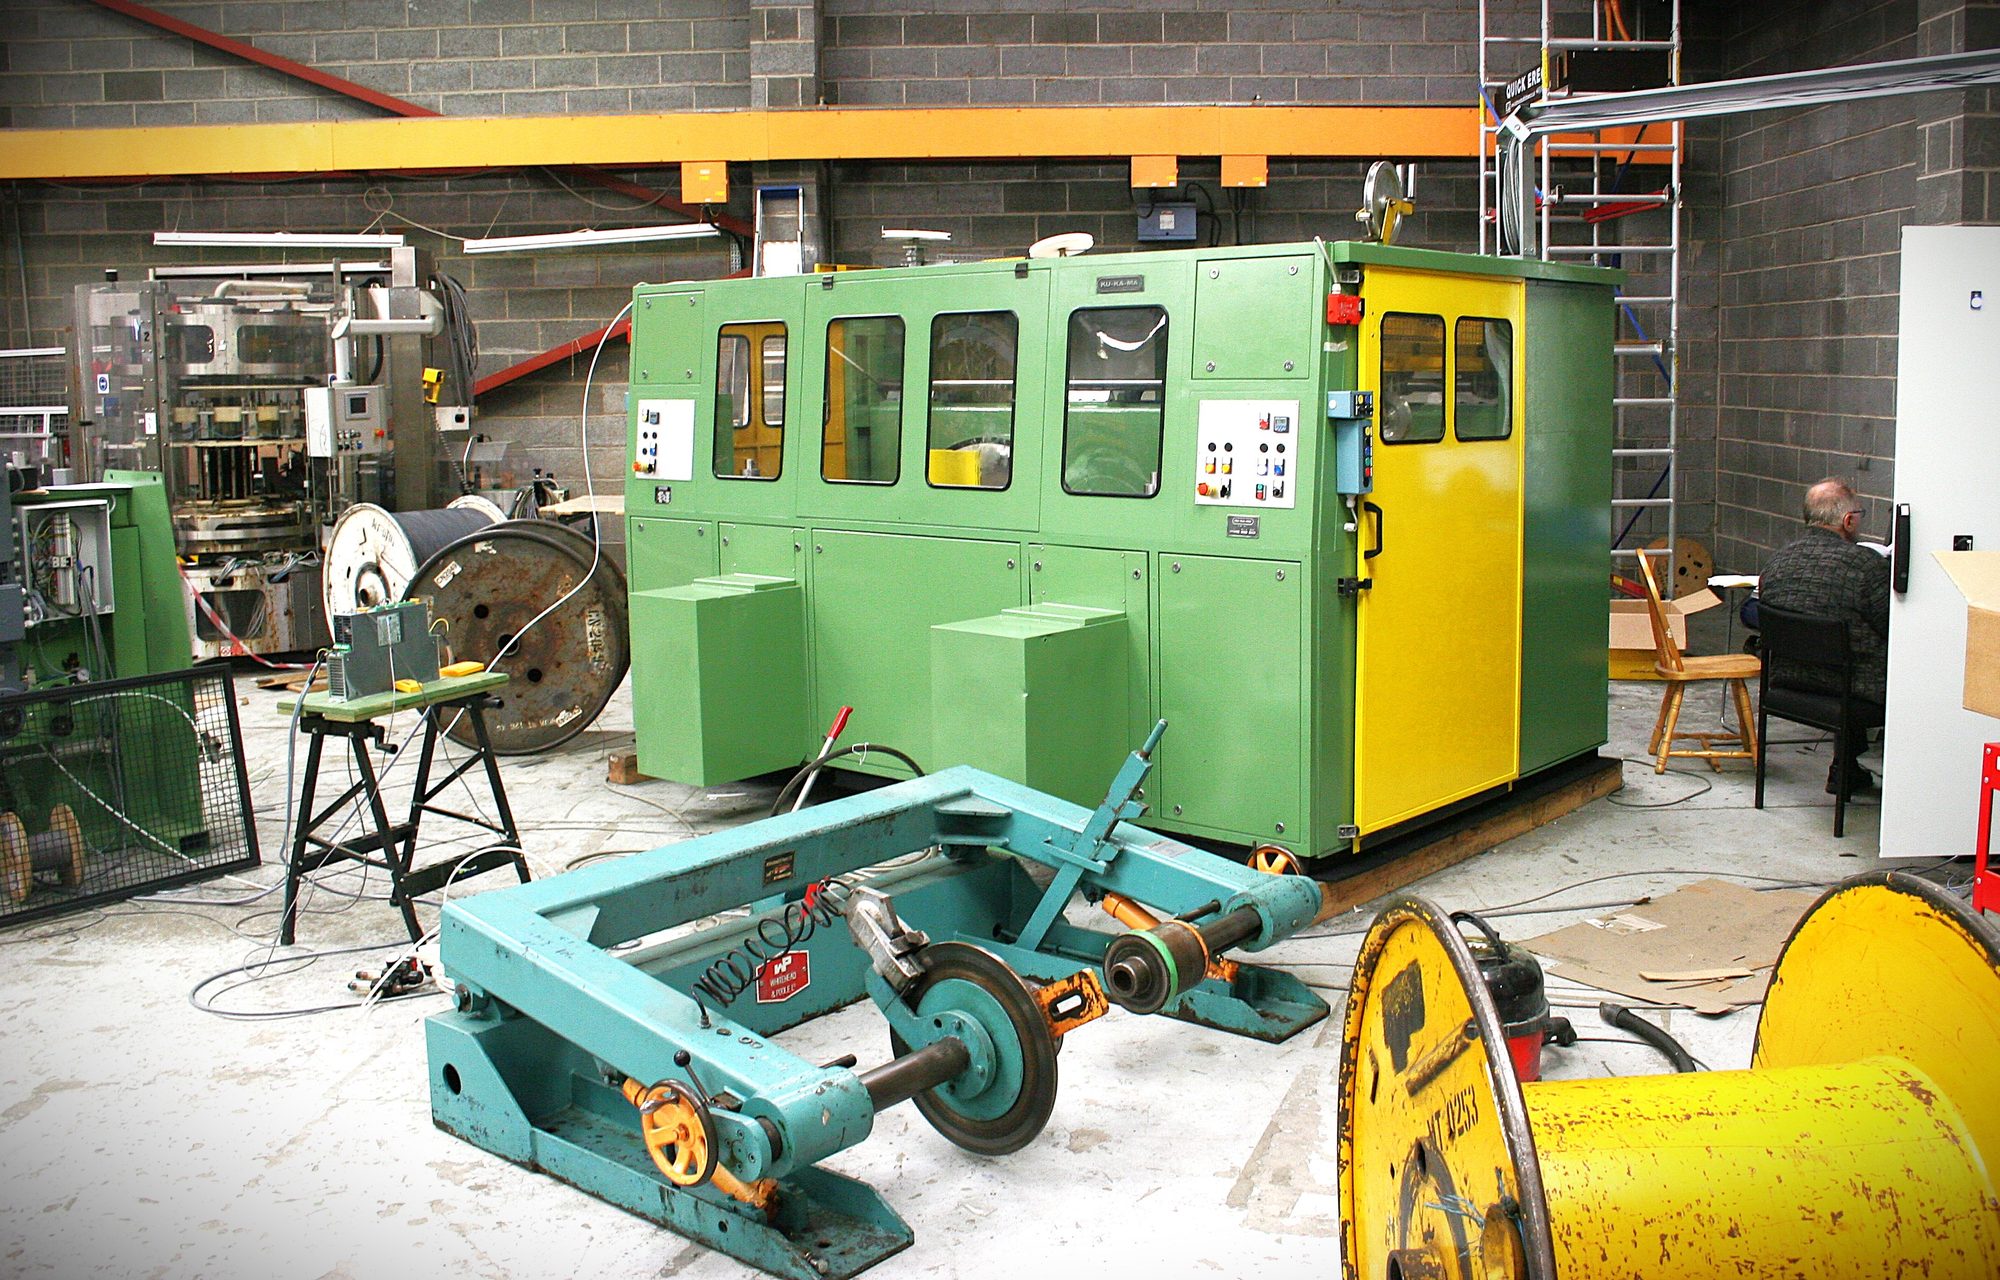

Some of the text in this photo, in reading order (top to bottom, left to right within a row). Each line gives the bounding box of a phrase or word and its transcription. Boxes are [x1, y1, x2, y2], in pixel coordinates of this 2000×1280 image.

[1506, 66, 1543, 99] QUICK ERE
[143, 331, 150, 341] 2
[774, 955, 792, 975] WP
